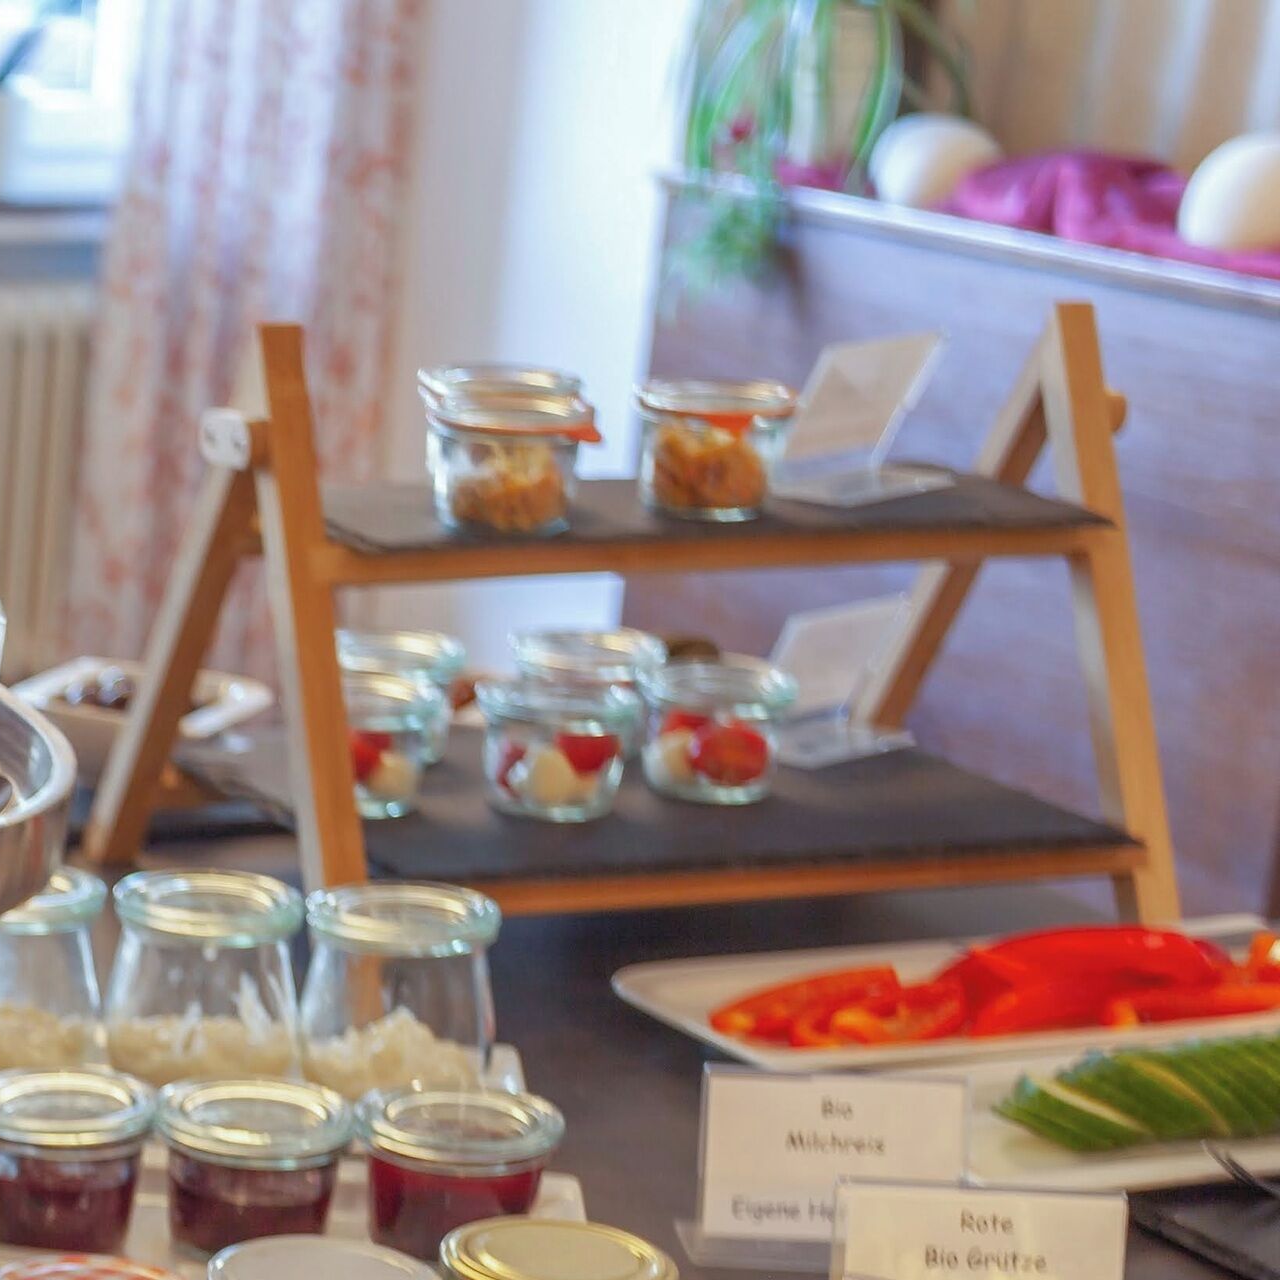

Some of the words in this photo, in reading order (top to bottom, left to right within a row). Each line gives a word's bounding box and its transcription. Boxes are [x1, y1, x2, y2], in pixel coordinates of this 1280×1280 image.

[821, 1096, 853, 1120] Bio
[785, 1130, 886, 1155] Milchreis
[961, 1208, 1014, 1233] Rote
[925, 1245, 959, 1270] Bio
